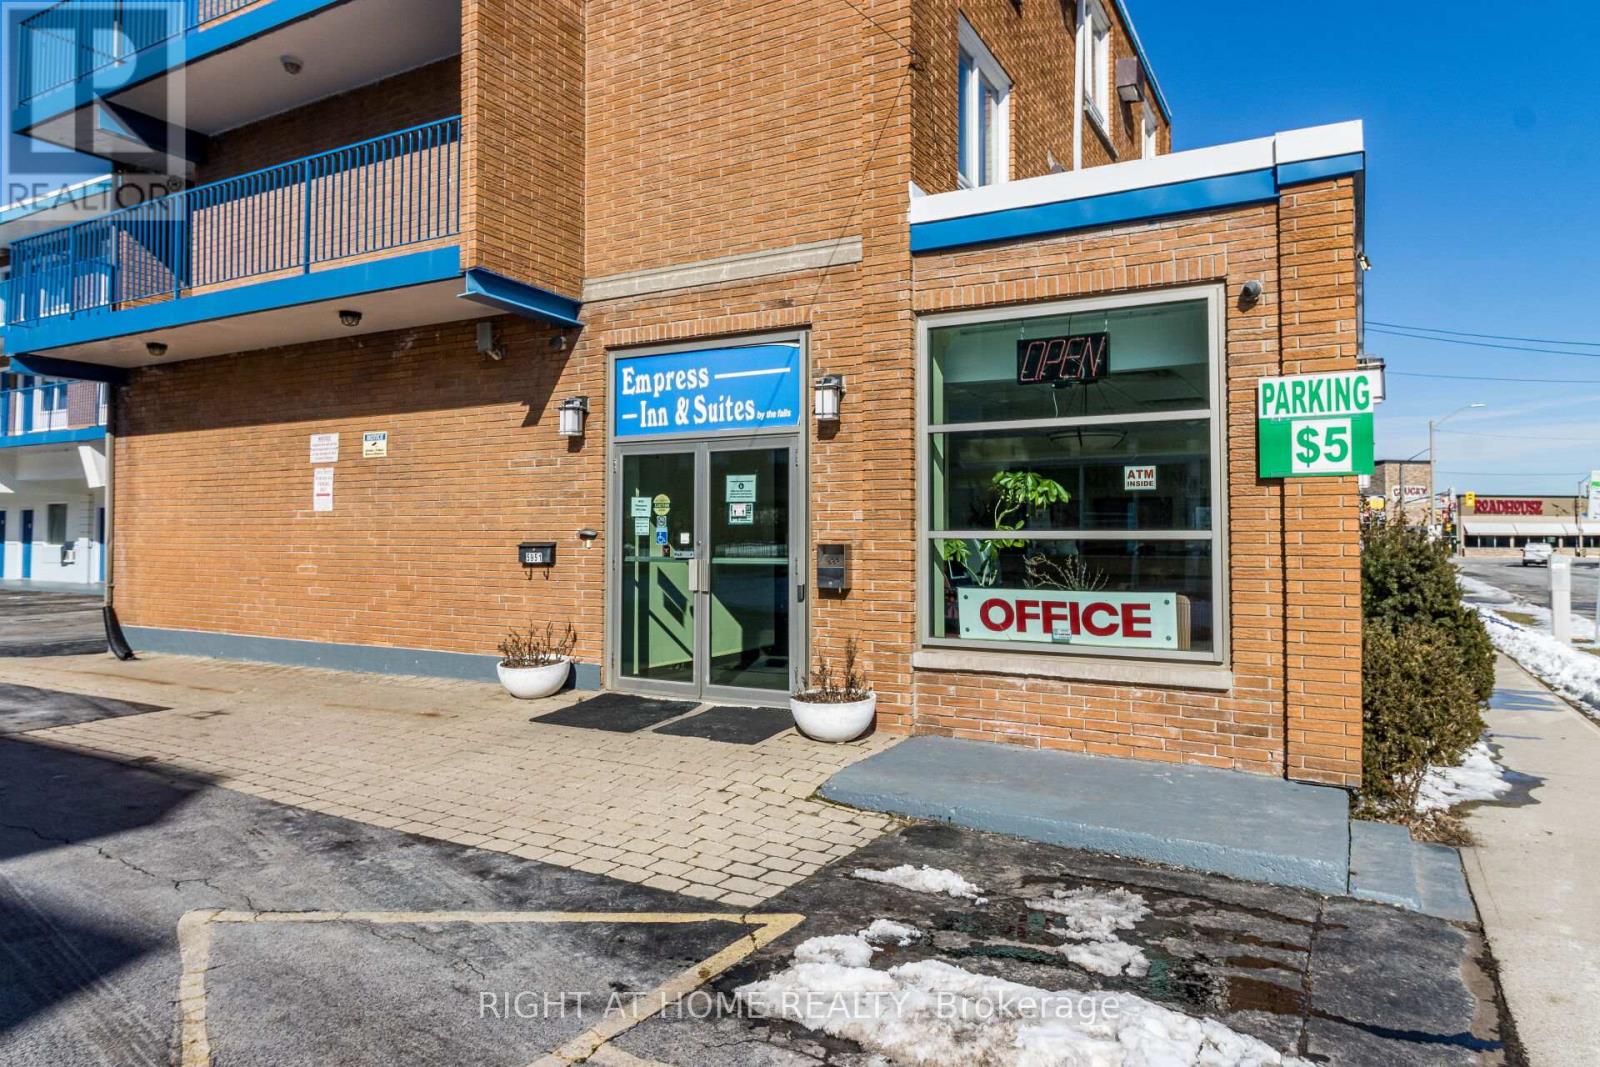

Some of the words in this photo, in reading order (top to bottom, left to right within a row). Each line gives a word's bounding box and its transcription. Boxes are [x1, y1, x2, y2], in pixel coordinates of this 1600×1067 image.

[1021, 336, 1105, 381] OPEN
[622, 366, 709, 398] Empress
[1262, 375, 1370, 416] PARKING
[640, 400, 668, 428] Inn
[675, 396, 689, 426] &
[693, 394, 755, 425] Suites
[757, 410, 766, 421] by
[766, 408, 777, 418] the
[777, 408, 791, 418] falls
[1296, 425, 1349, 468] $5
[1128, 469, 1154, 479] ATM
[1474, 499, 1543, 515] ROADHOUSE
[980, 598, 1152, 639] OFFICE
